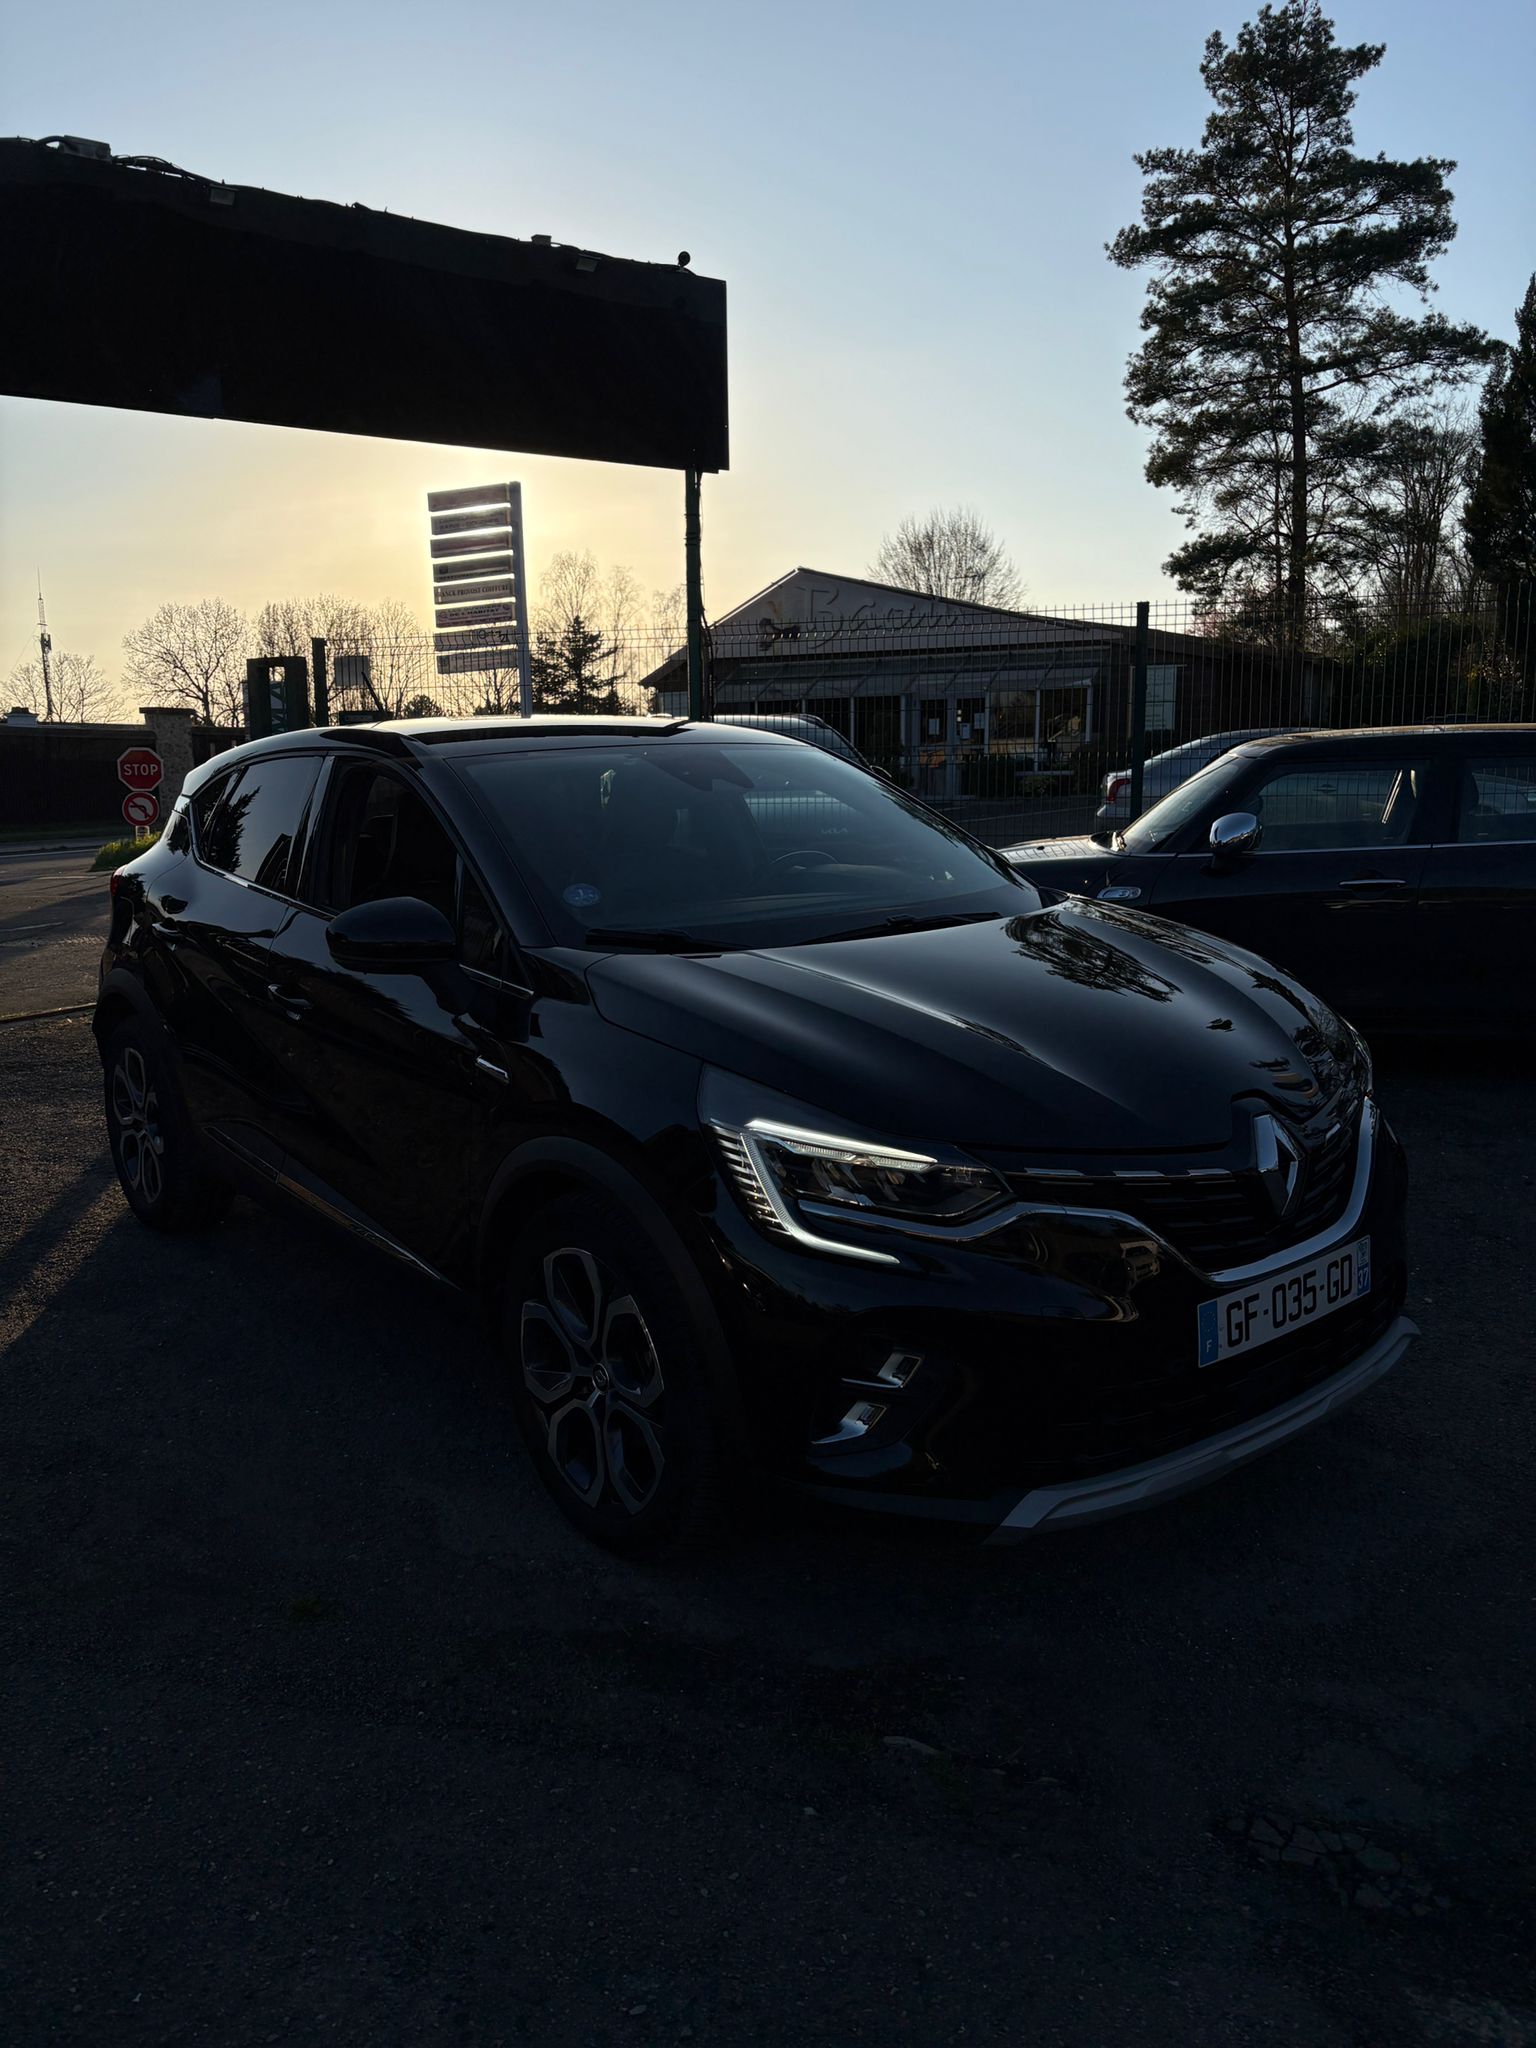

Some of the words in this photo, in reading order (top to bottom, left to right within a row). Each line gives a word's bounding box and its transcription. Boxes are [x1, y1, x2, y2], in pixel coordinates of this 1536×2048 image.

[123, 764, 159, 776] STOP
[1226, 1253, 1353, 1347] GF-035-GD
[1205, 1339, 1213, 1353] F
